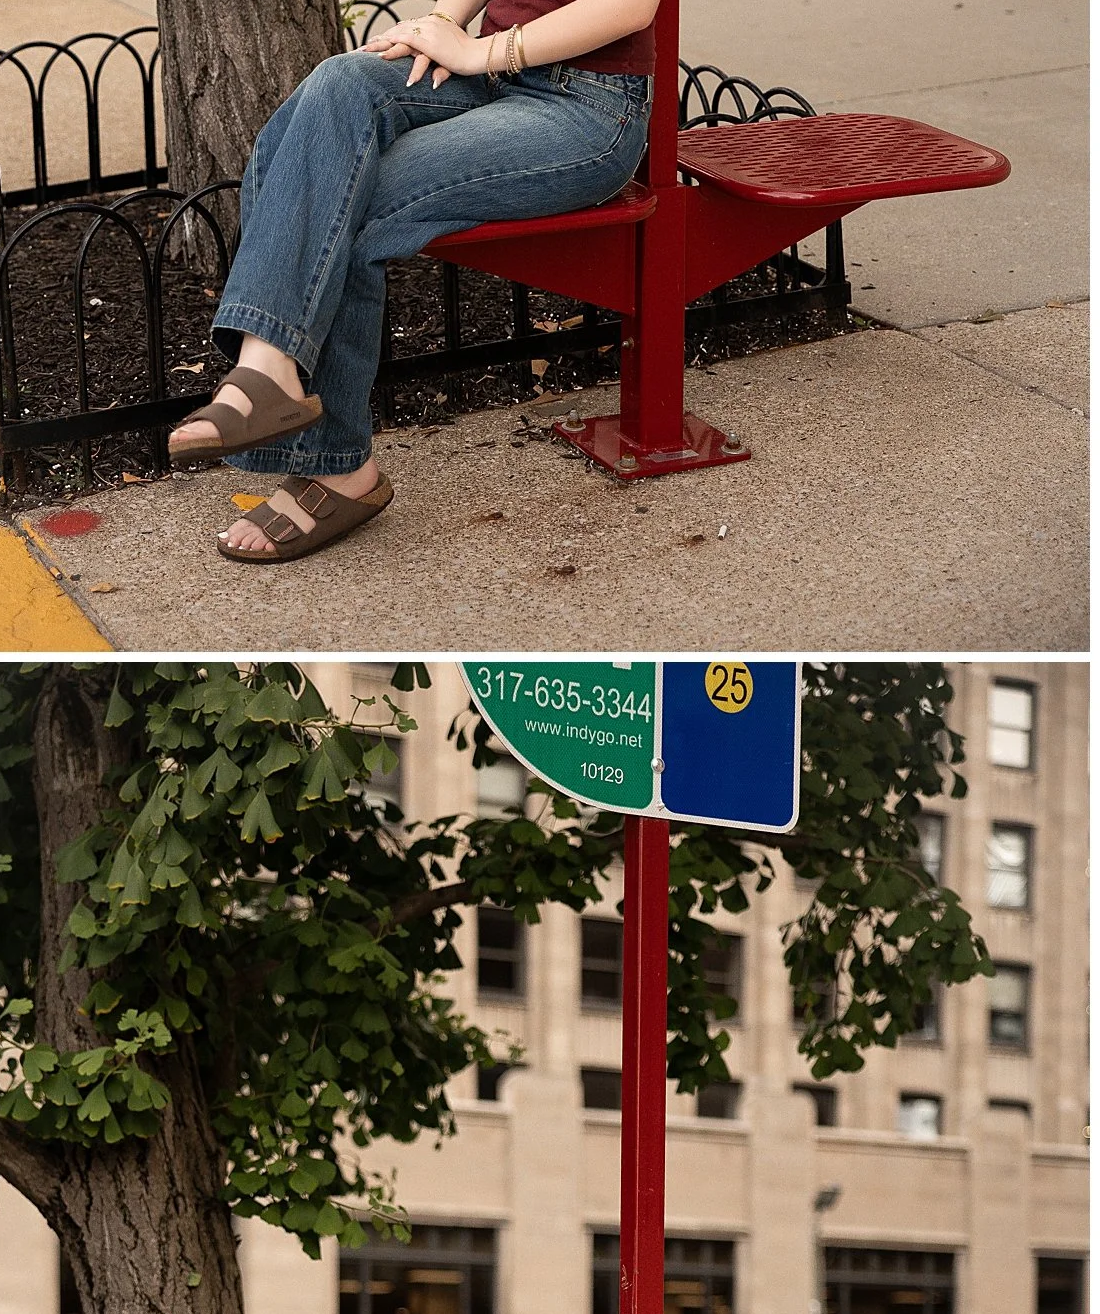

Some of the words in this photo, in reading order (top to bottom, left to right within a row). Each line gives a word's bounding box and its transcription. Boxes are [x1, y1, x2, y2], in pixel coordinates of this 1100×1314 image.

[477, 667, 652, 723] 317-635-3344
[711, 664, 748, 705] 25
[524, 718, 643, 748] www.indygo.net
[580, 762, 624, 785] 10129
